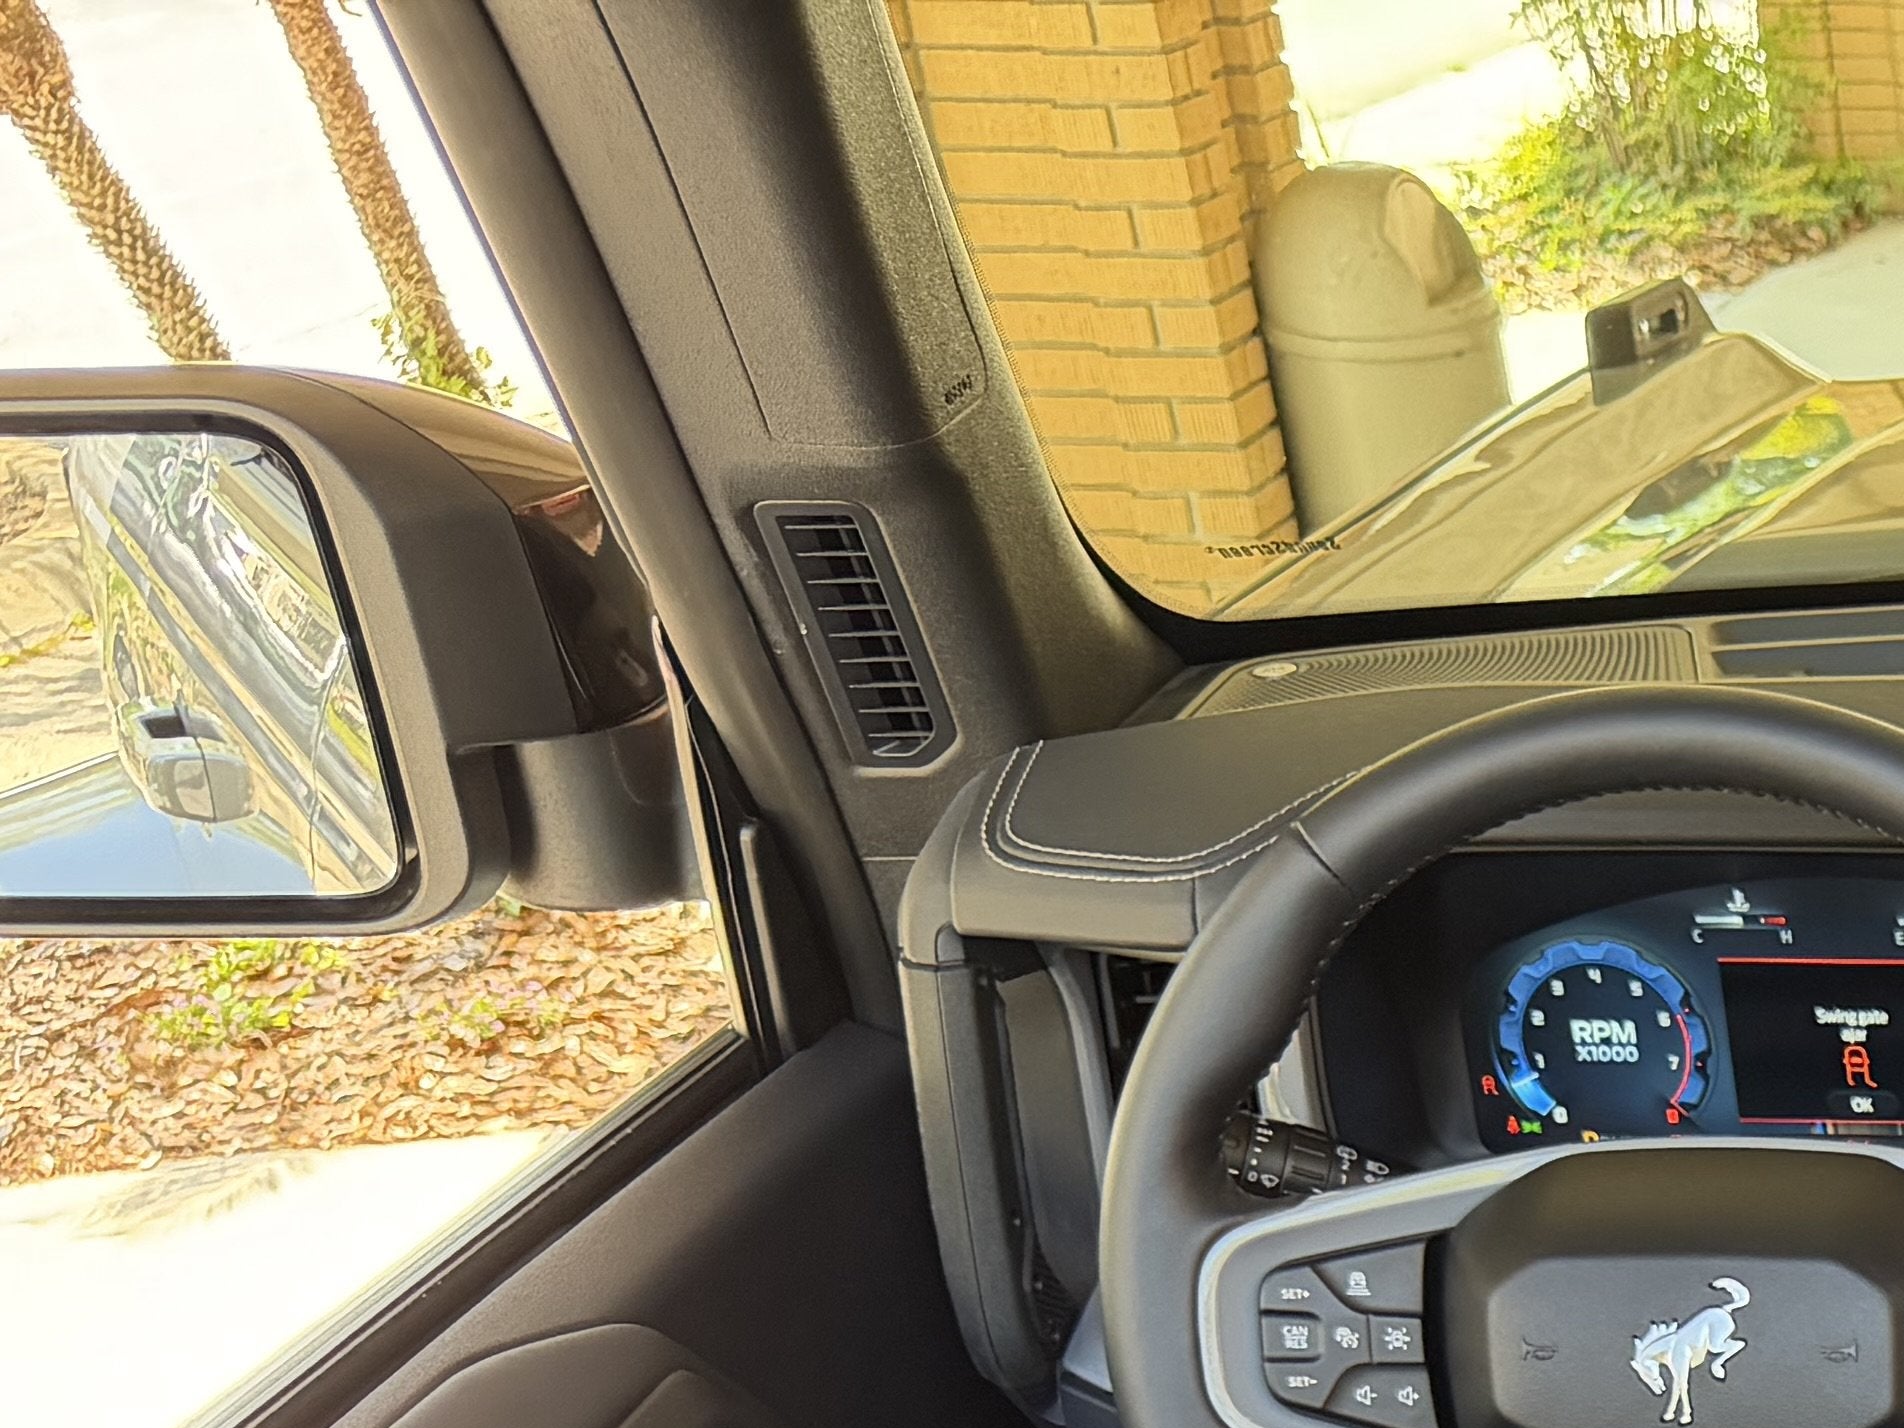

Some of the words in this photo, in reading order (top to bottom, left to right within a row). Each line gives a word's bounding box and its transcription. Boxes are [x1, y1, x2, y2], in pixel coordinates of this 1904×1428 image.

[1691, 928, 1704, 944] C
[1779, 928, 1793, 944] H
[1530, 1009, 1545, 1026] 2
[1814, 1006, 1857, 1026] Swing
[1569, 1019, 1637, 1044] RPM
[1575, 1045, 1640, 1062] X1000
[1668, 1055, 1680, 1071] 7
[1850, 1096, 1874, 1113] OK
[1282, 1325, 1308, 1335] CAN
